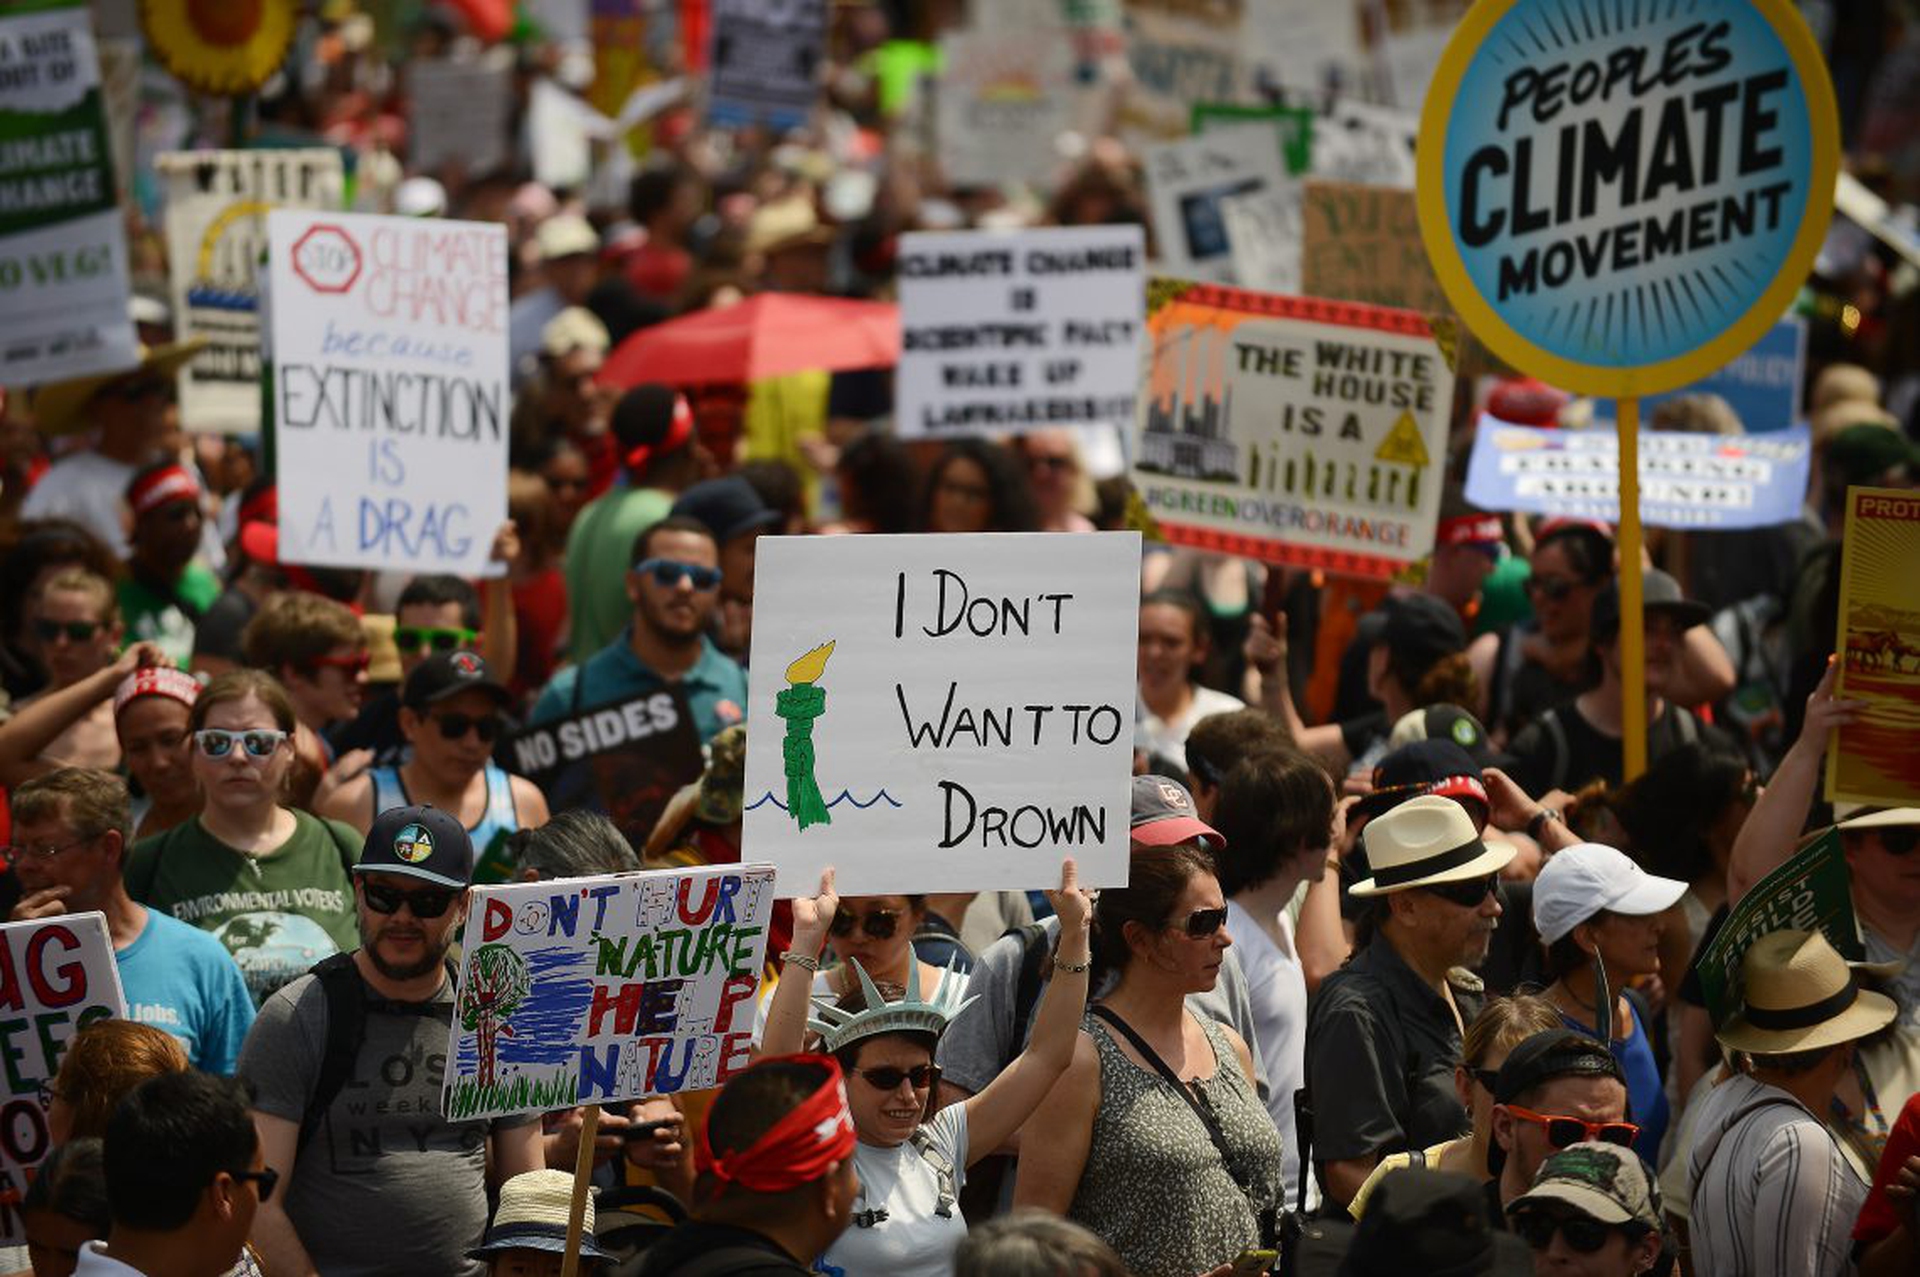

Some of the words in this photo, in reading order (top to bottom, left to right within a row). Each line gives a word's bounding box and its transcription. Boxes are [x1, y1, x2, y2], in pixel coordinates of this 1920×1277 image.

[1496, 20, 1732, 131] PEOPLES
[1459, 68, 1789, 247] CLIMATE
[371, 226, 507, 275] CLIMATE
[901, 250, 1012, 278] CLIMATE
[1026, 246, 1134, 274] CHANGE
[1498, 181, 1793, 303] MOVEMENT
[366, 269, 507, 333] CHANGE
[322, 319, 474, 365] because
[1064, 321, 1134, 345] FACT
[1235, 341, 1306, 378] THE
[1315, 339, 1434, 382] WHITE
[1045, 359, 1081, 384] UP
[1311, 372, 1436, 412] HOUSE
[281, 365, 502, 441] EXTINCTION
[1283, 403, 1325, 437] IS
[1339, 412, 1363, 442] A
[369, 437, 406, 486] IS
[309, 494, 337, 553] A
[358, 496, 473, 559] DRAG
[1147, 486, 1411, 547] #GREENOVERORANGE
[895, 572, 905, 638] I
[514, 729, 558, 775] NO
[558, 692, 679, 762] SIDES
[1062, 704, 1122, 746] TO
[172, 888, 292, 922] ENVIRONMENTAL
[292, 886, 345, 914] VOTERS
[483, 885, 621, 943] DON'T
[635, 868, 776, 928] HURT
[589, 923, 763, 979] NATURE
[132, 1001, 182, 1026] Jobs.
[587, 974, 760, 1040] HELP
[577, 1032, 752, 1099] NATURE
